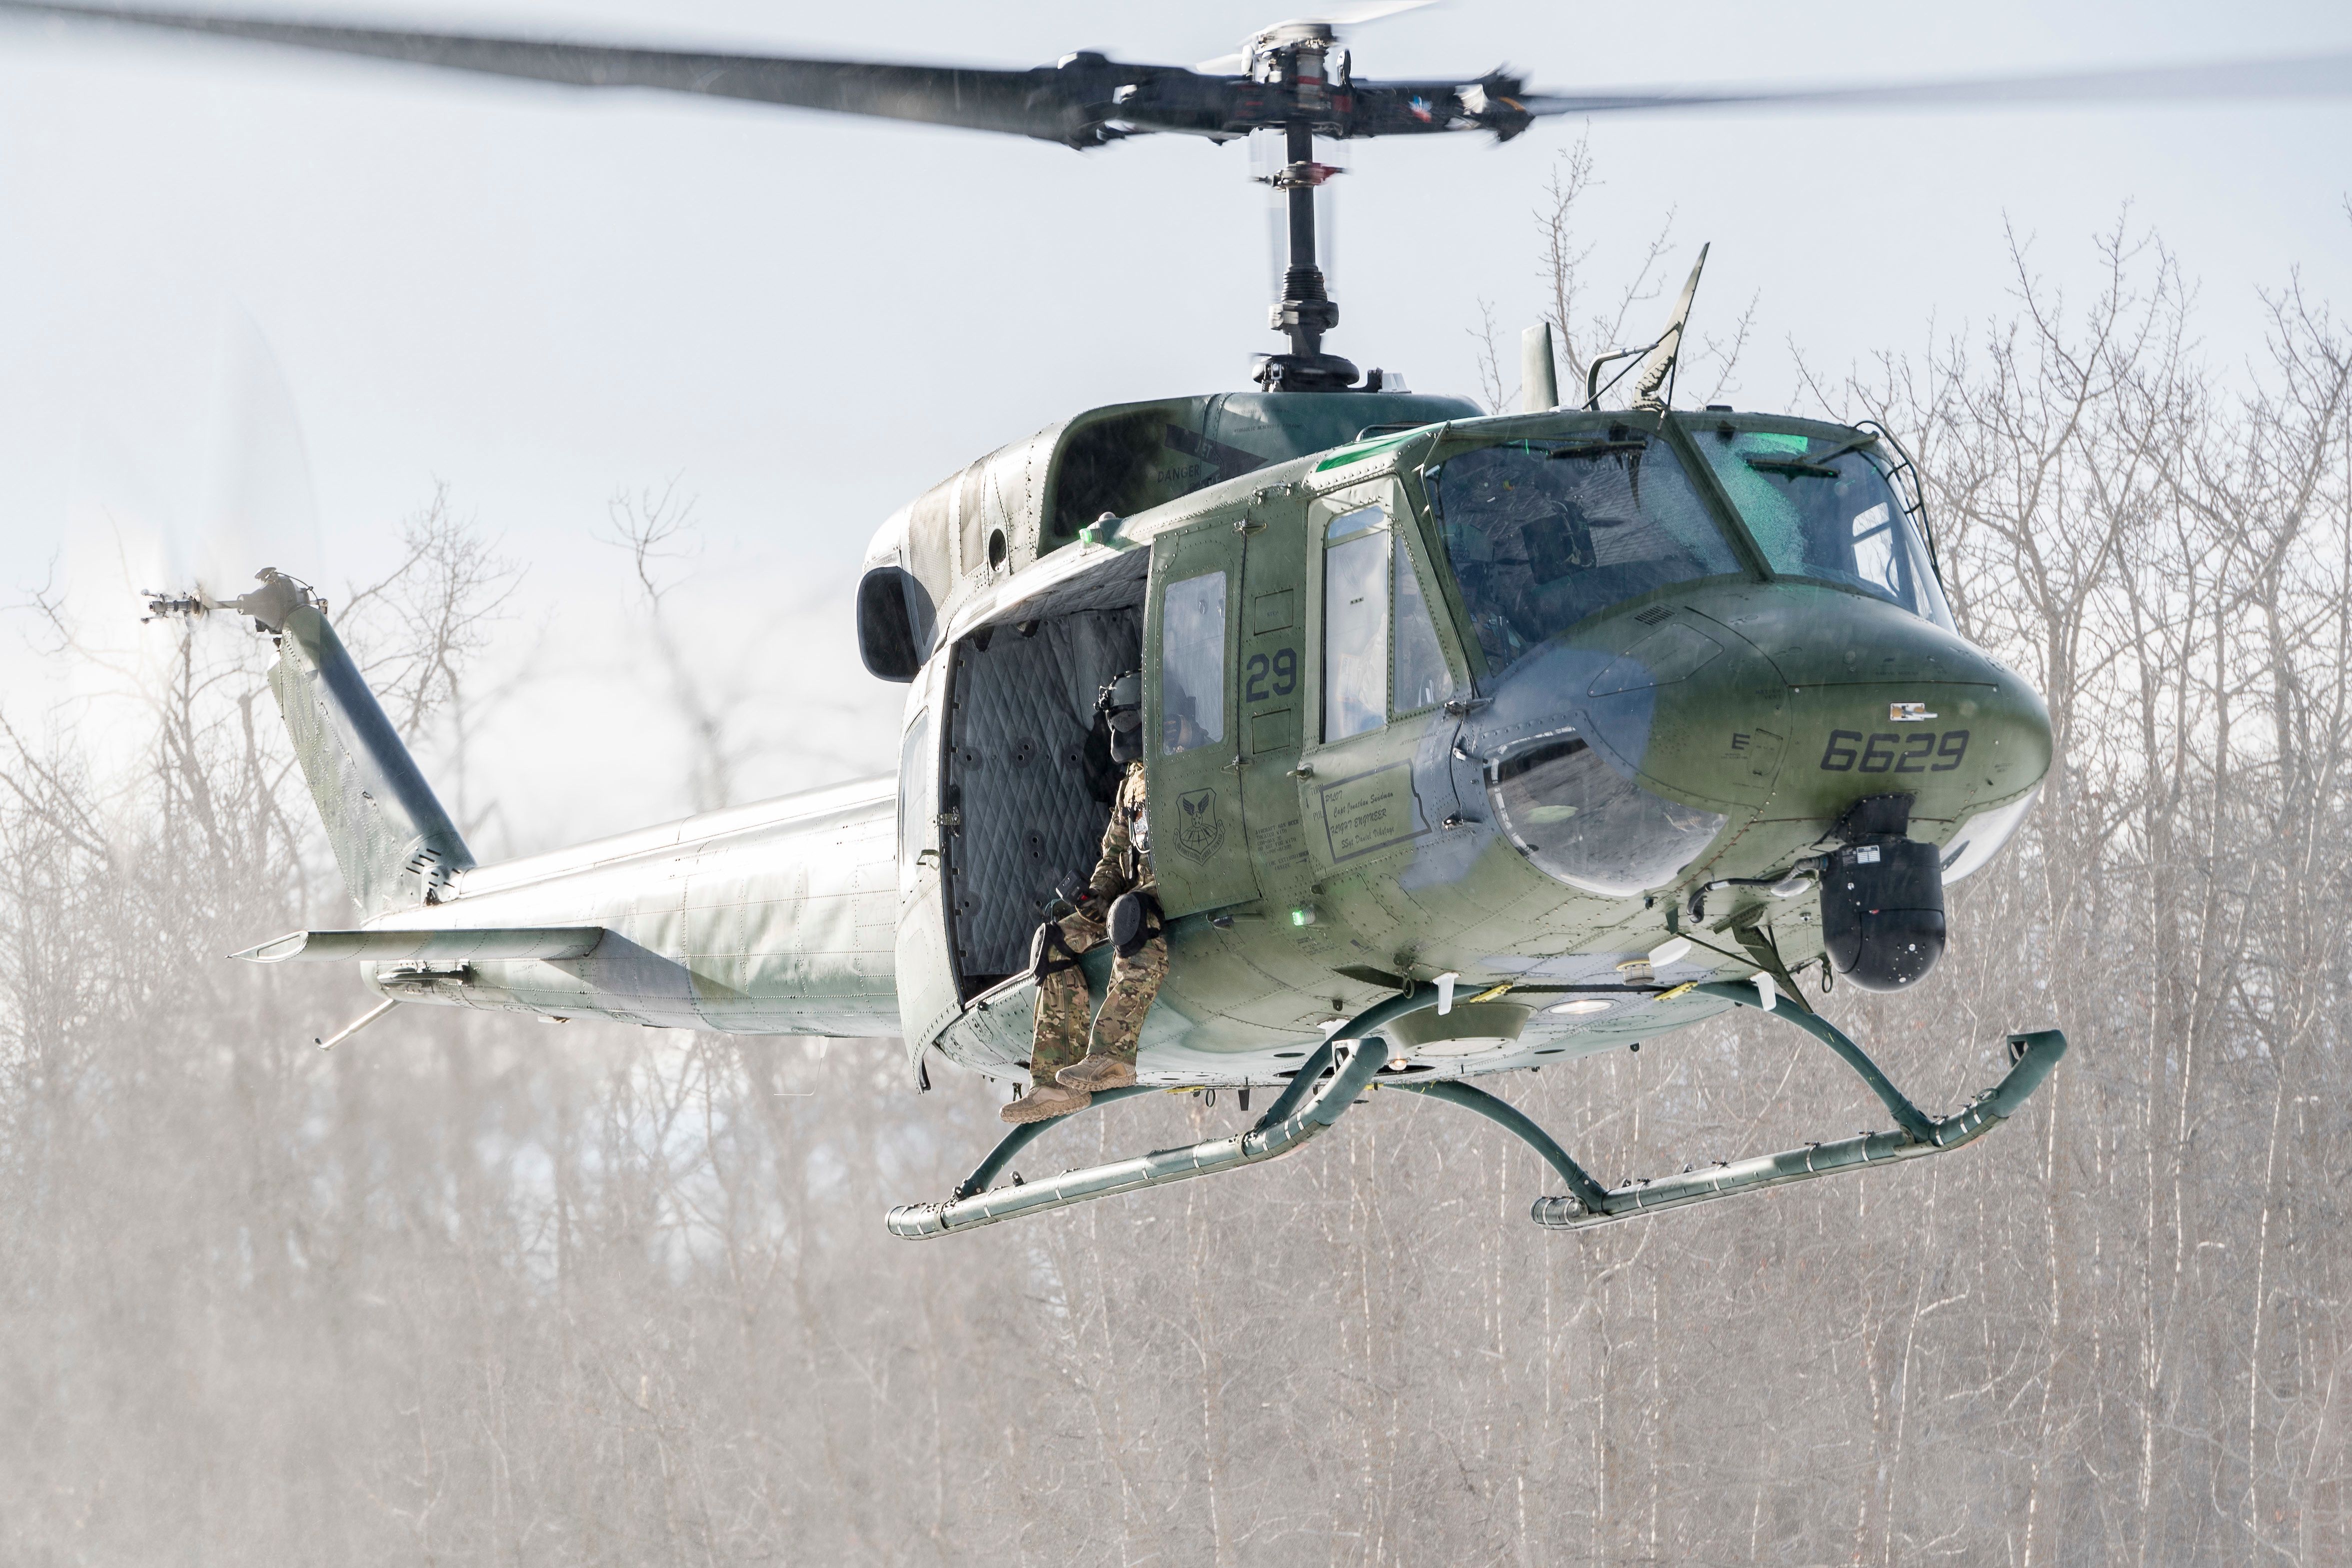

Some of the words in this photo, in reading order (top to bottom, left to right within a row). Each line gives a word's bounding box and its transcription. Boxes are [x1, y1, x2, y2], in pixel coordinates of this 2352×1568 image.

[1157, 464, 1200, 483] DANGER
[1246, 647, 1297, 703] 29
[1820, 728, 1970, 773] 6629
[1325, 790, 1343, 804] PILOT
[1334, 806, 1345, 818] Capt
[1347, 798, 1369, 814] Jonathan
[1370, 792, 1394, 803] Sundman
[1256, 825, 1276, 835] AIRCRAFT
[1330, 820, 1352, 836] FLIGHT
[1354, 808, 1387, 828] ENGINEER
[1201, 848, 1212, 861] STRIKE
[1211, 834, 1223, 851] COMMAND
[1341, 838, 1354, 849] SSgt
[1355, 832, 1372, 844] Daniel
[1278, 850, 1309, 864] EXTINGUISHER
